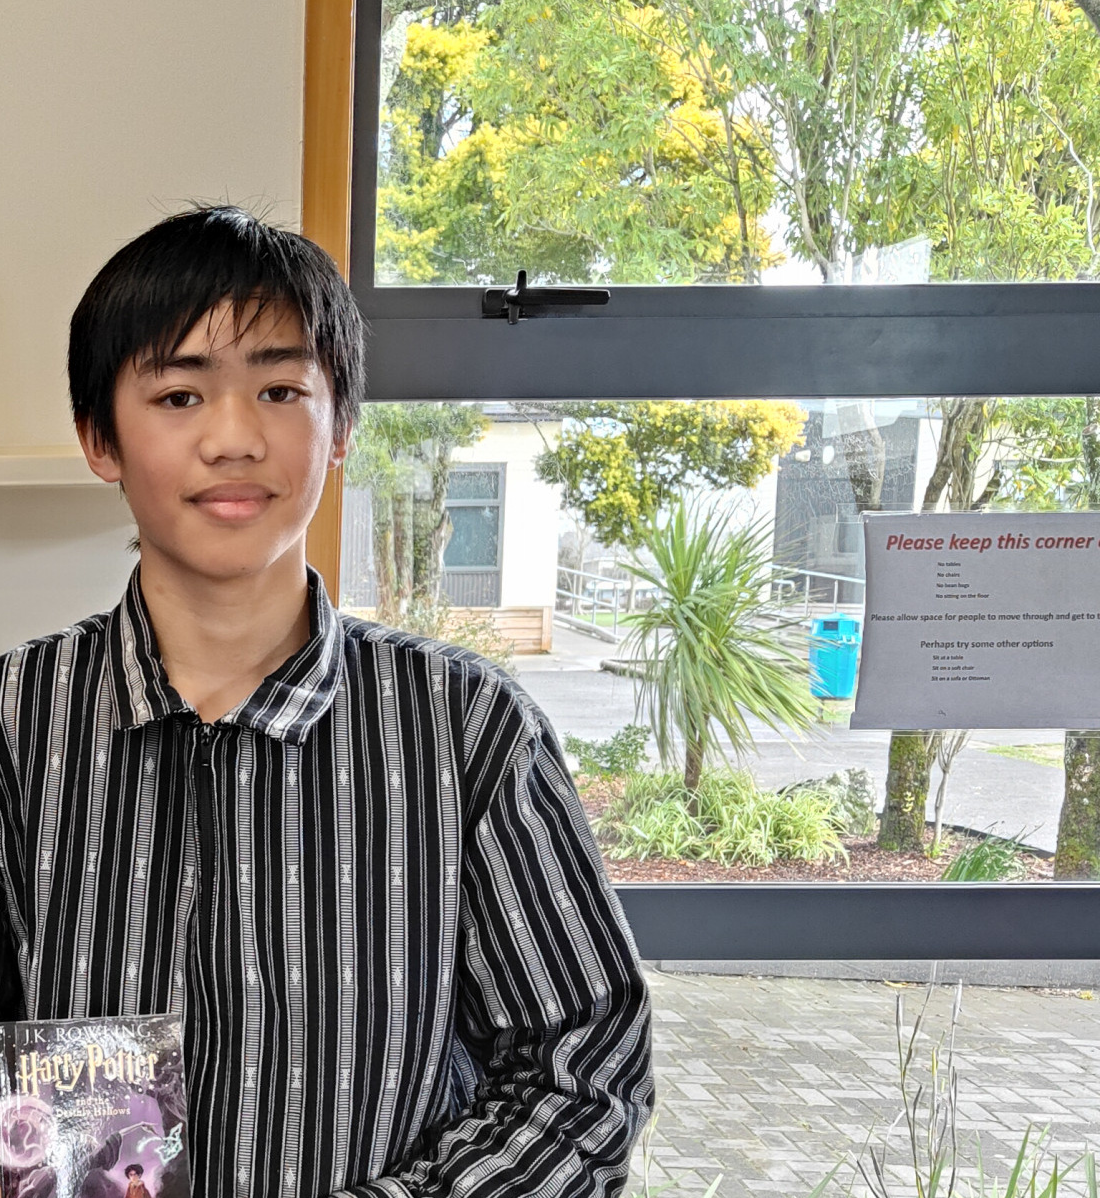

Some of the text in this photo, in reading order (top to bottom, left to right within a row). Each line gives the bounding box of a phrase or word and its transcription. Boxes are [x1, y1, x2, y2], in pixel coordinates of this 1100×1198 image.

[886, 534, 944, 550] Please
[949, 534, 992, 553] keep
[997, 534, 1030, 549] this
[1035, 536, 1094, 549] corner
[958, 614, 985, 622] people
[1023, 613, 1054, 621] through
[1072, 614, 1084, 622] get
[921, 640, 954, 649] Perhaps
[957, 640, 969, 649] try
[997, 640, 1020, 648] other
[1022, 640, 1053, 649] options
[25, 1024, 151, 1045] J.K. ROWLING
[19, 1044, 158, 1097] Harry Potter
[93, 1108, 130, 1116] Hallows
